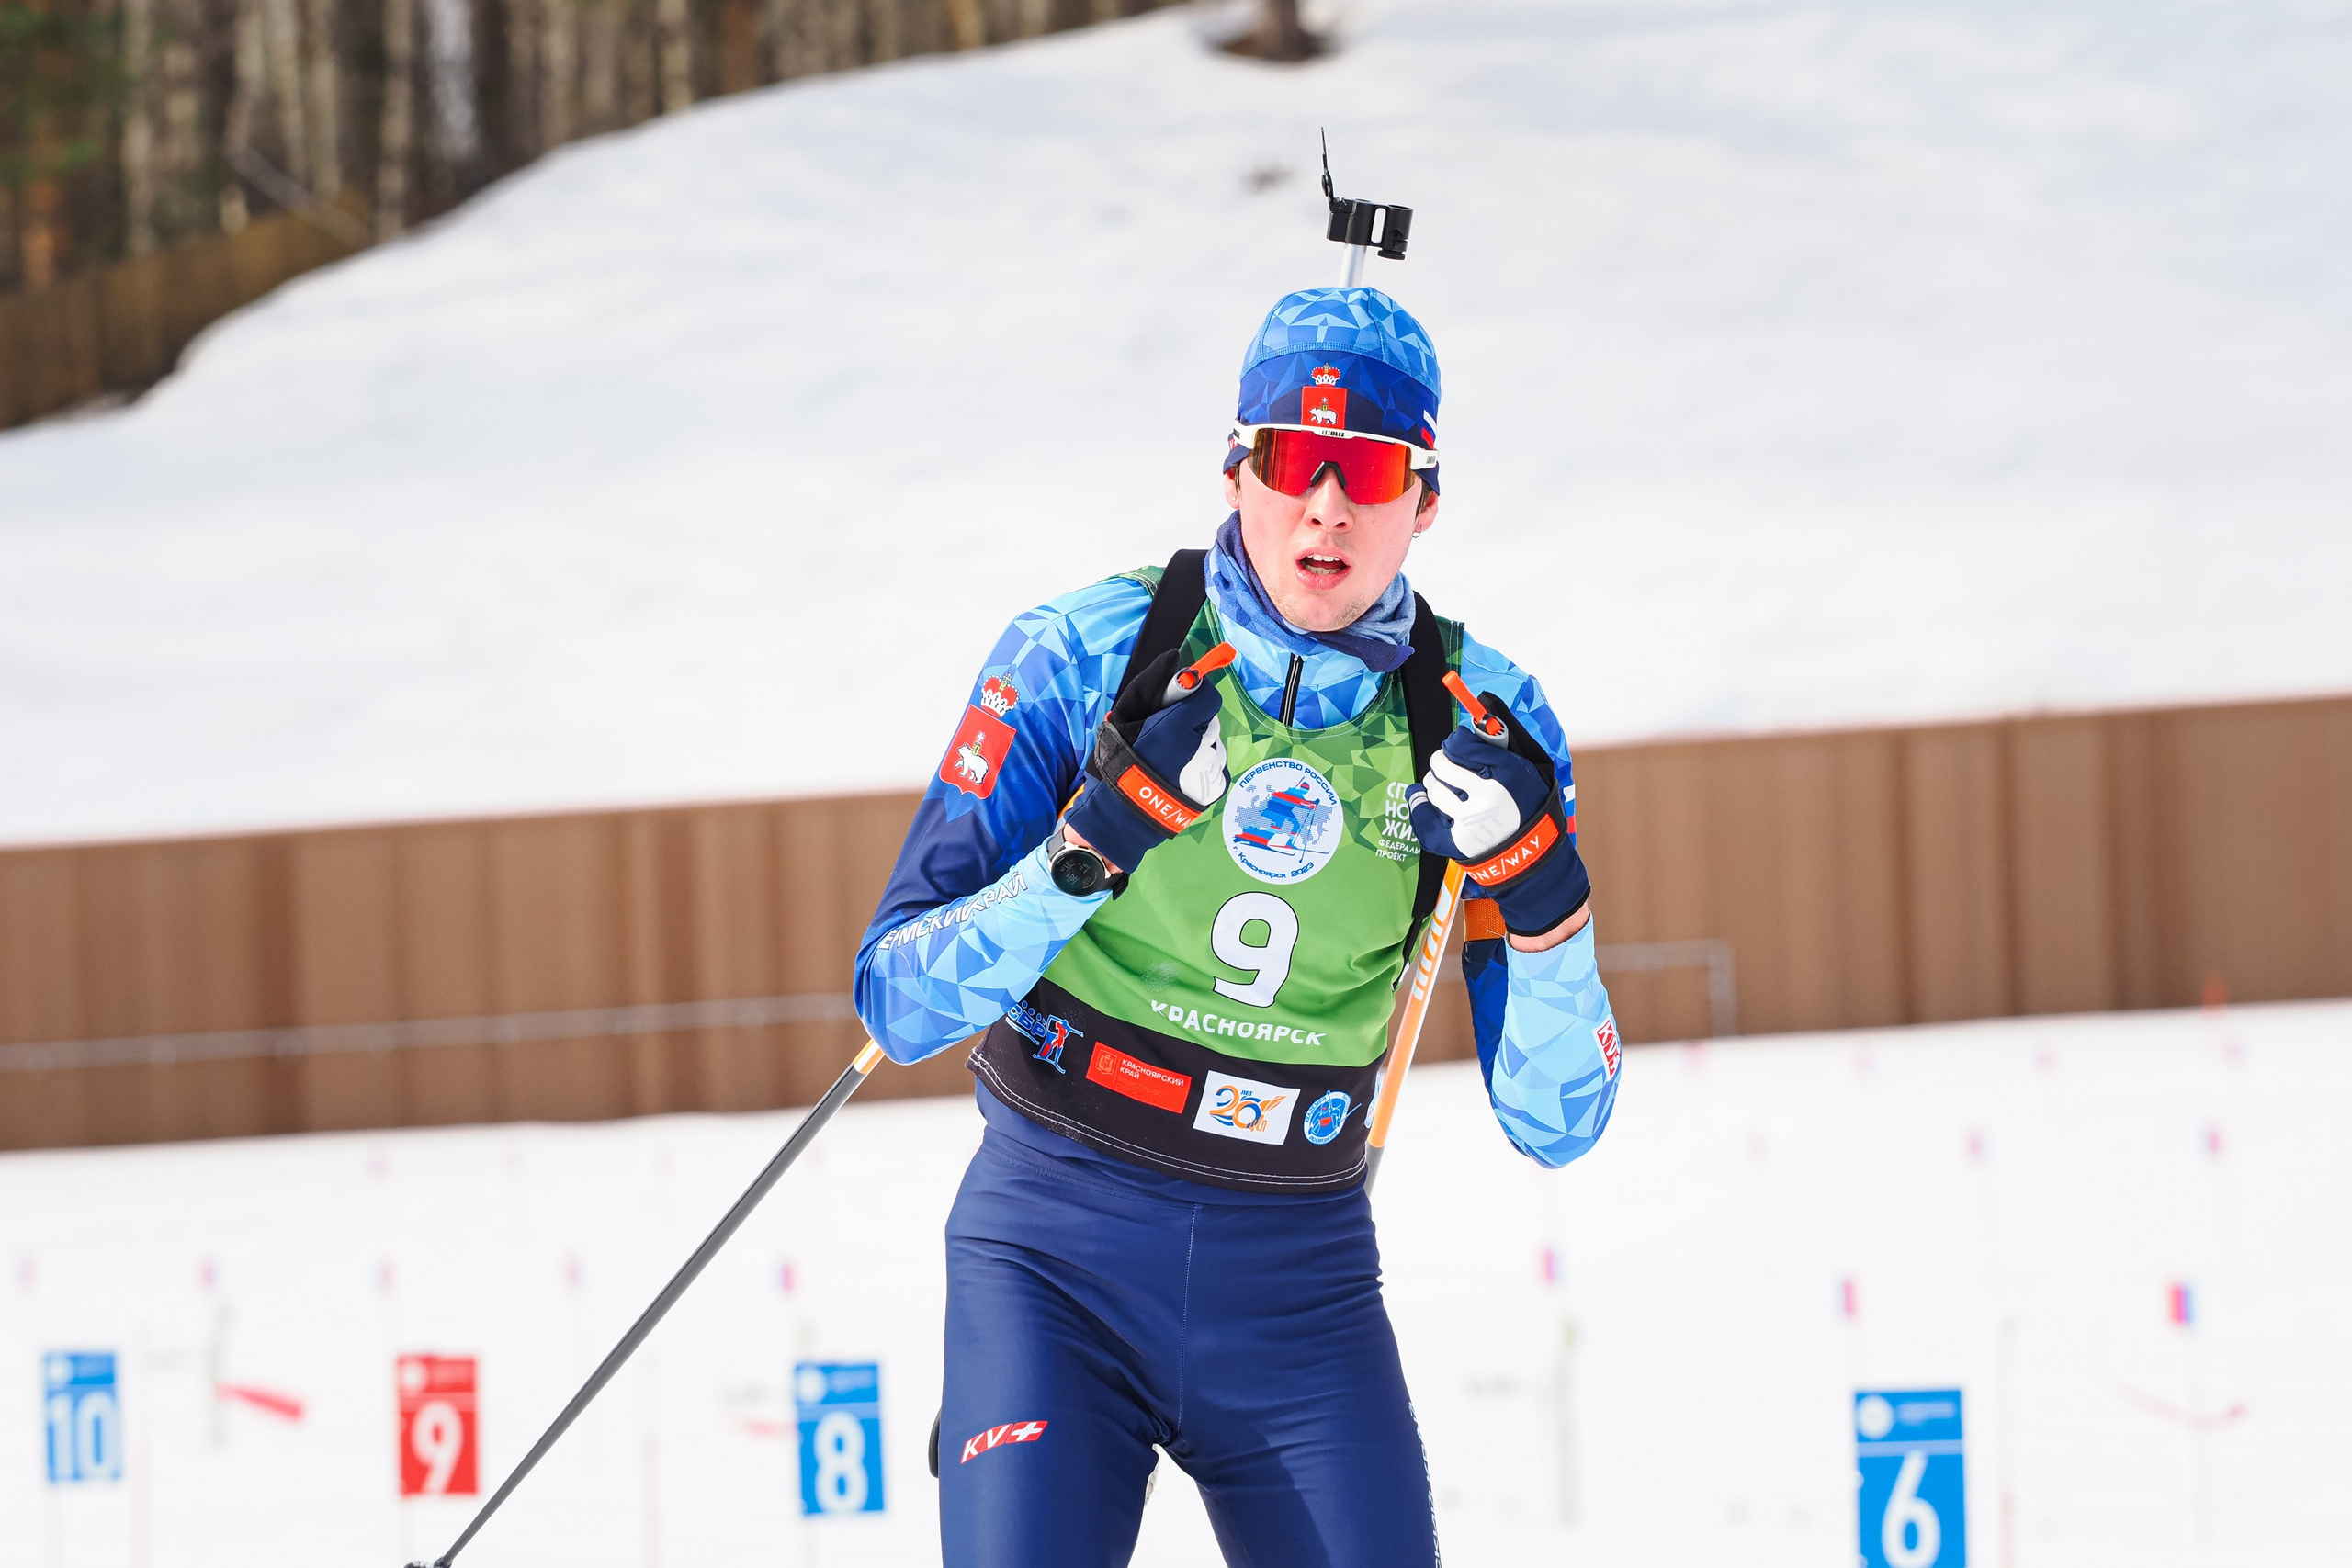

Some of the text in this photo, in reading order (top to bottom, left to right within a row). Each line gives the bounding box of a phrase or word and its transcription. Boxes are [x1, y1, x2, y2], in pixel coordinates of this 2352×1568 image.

[1238, 761, 1338, 806] ПЕРВЕНСТВО РОССИИ
[1238, 852, 1287, 879] Красноярск
[1290, 862, 1315, 877] 2023
[1375, 848, 1408, 863] ПРОЕКТ
[1378, 838, 1421, 855] ФЕДЕРАЛЬ
[1210, 890, 1300, 1009] 9
[1150, 999, 1327, 1046] КРАСНОЯРСК
[1119, 1066, 1140, 1079] КРАЙ
[1122, 1058, 1185, 1087] КРАСНОЯРСКИЙ
[47, 1392, 122, 1481] 10
[412, 1400, 464, 1495] 9
[814, 1411, 869, 1516] 8
[1882, 1450, 1941, 1568] 6
